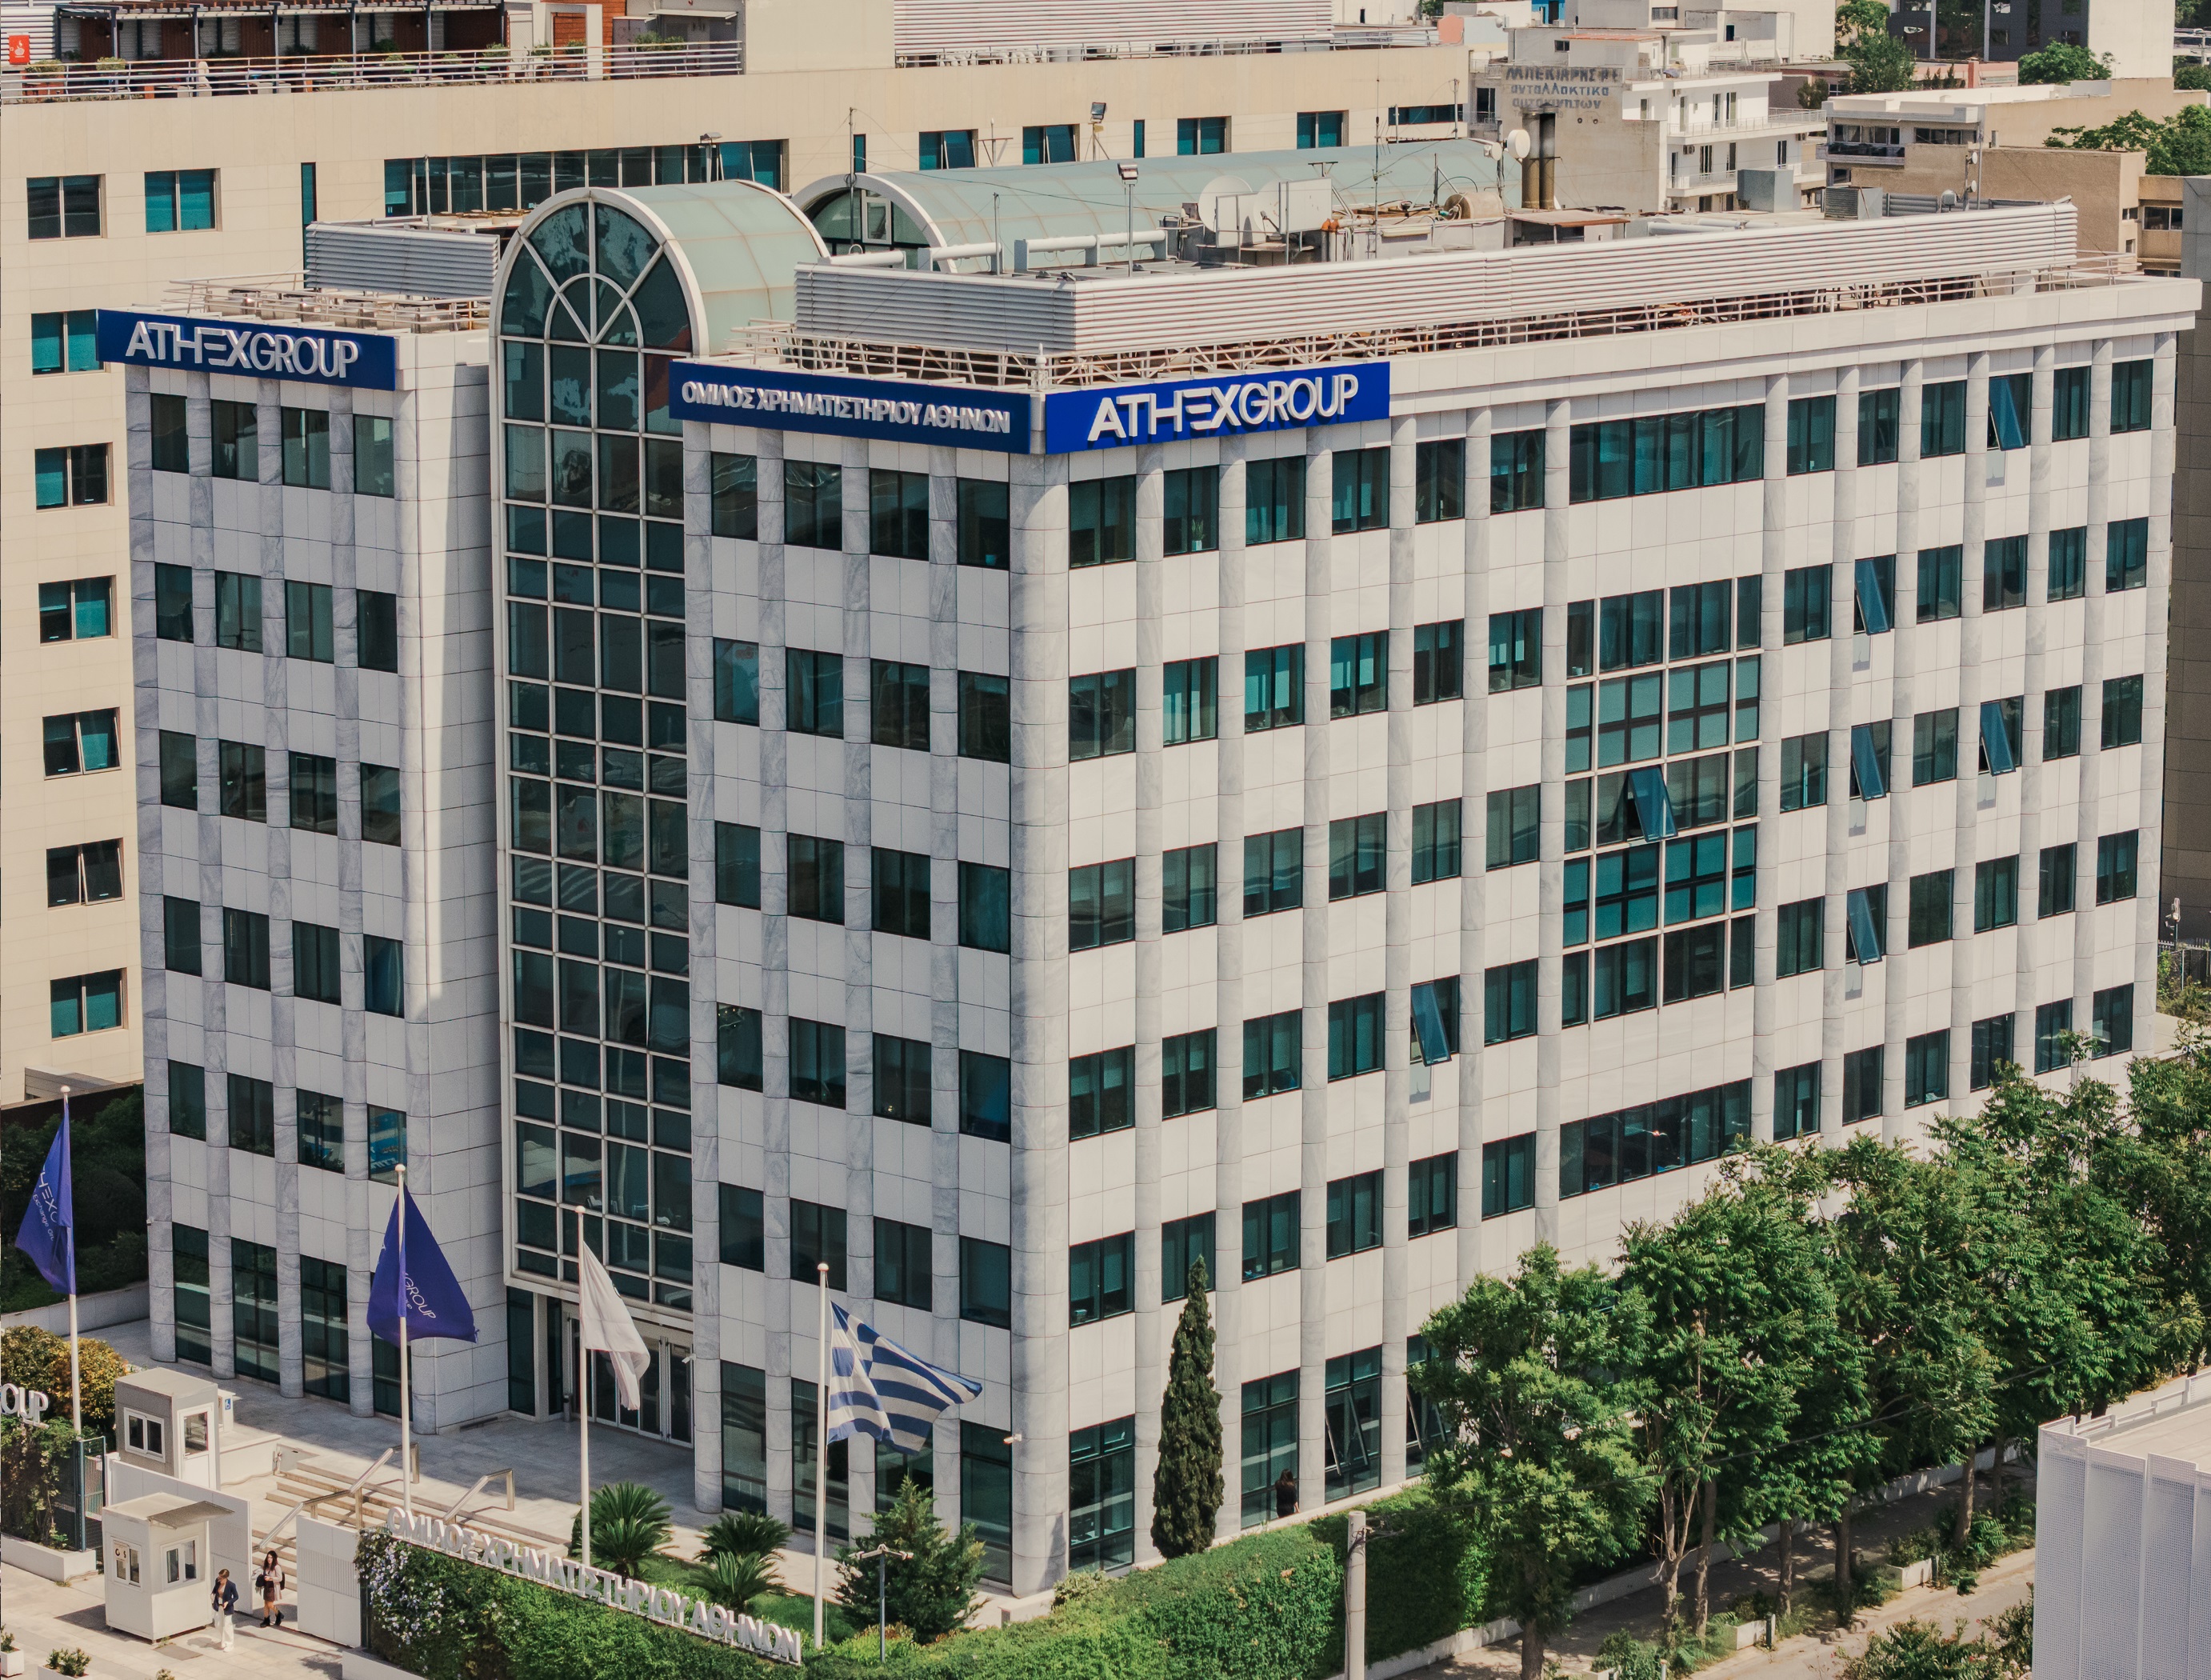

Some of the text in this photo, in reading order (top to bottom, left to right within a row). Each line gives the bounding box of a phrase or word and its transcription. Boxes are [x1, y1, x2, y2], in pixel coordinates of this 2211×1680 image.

[126, 321, 358, 378] ATHEXGROUP
[682, 381, 1010, 434] ΟΜΙΛΟΣ ΧΡΗΜΑΤΙΣΤΗΡΙΟΥ ΑΘΗΝΩΝ
[1087, 374, 1359, 442] ATHEXGROUP
[388, 1506, 801, 1664] ΟΜΙΛΟΣ ΧΡΗΜΑΤΙΣΤΗΡΙΟΥ ΑΘΗΝΩΝ
